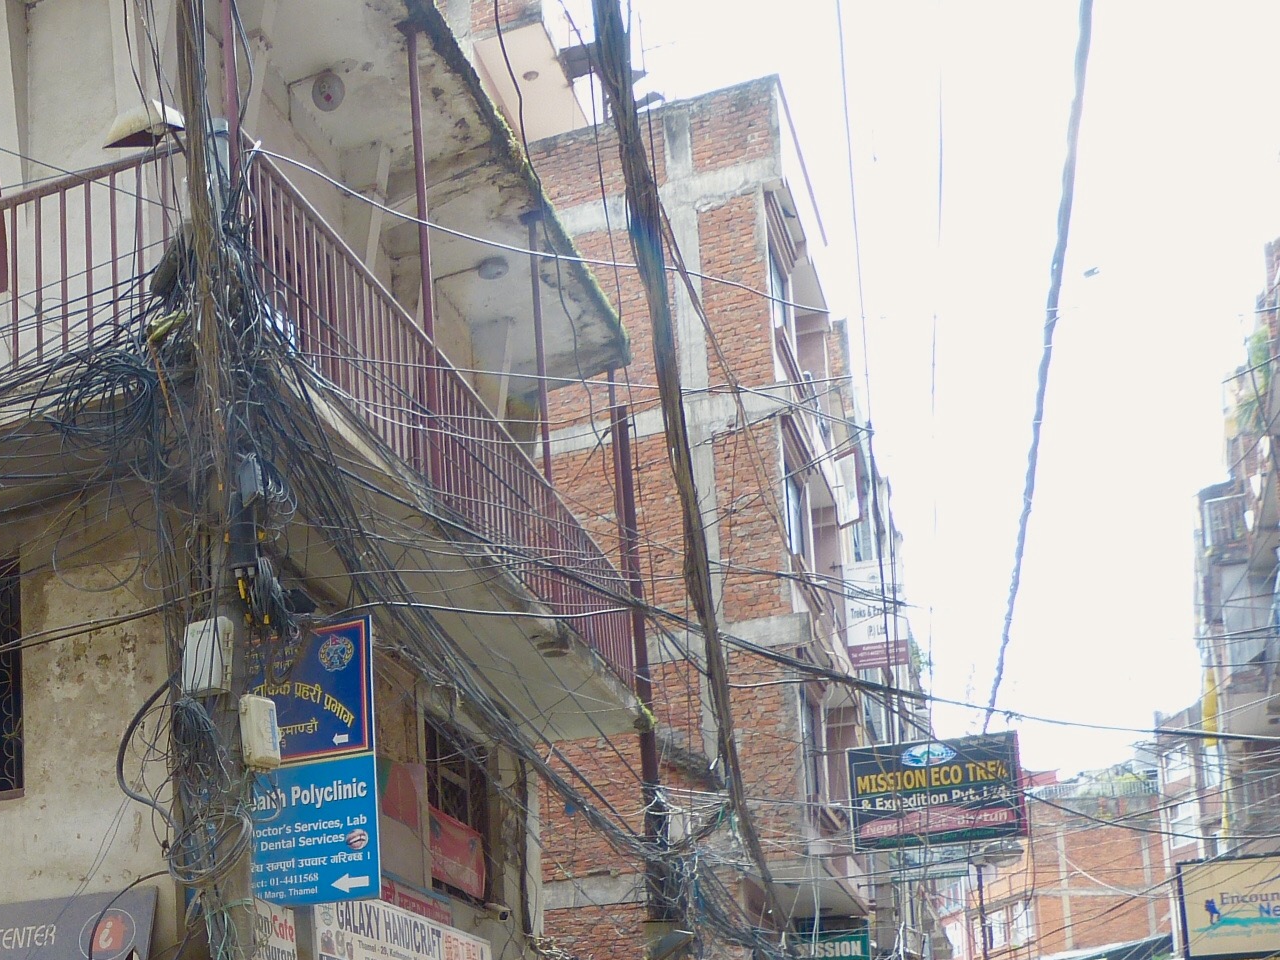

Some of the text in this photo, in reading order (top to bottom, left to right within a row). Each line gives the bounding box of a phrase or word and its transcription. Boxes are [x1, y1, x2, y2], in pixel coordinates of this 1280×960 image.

[295, 682, 355, 728] प्रहरी प्रभाग
[857, 769, 927, 795] MISSION
[931, 765, 963, 786] ECO
[291, 778, 368, 809] Polyclinic
[862, 799, 872, 811] &
[876, 793, 948, 811] Expedition
[294, 819, 343, 833] Services,
[347, 814, 367, 827] Lab
[261, 833, 345, 851] Dental Services
[269, 872, 319, 886] 01-4411568
[288, 886, 318, 896] Thamel
[272, 914, 294, 942] Cafe
[336, 901, 379, 940] GALAXY
[383, 909, 441, 960] HANDICRAFT
